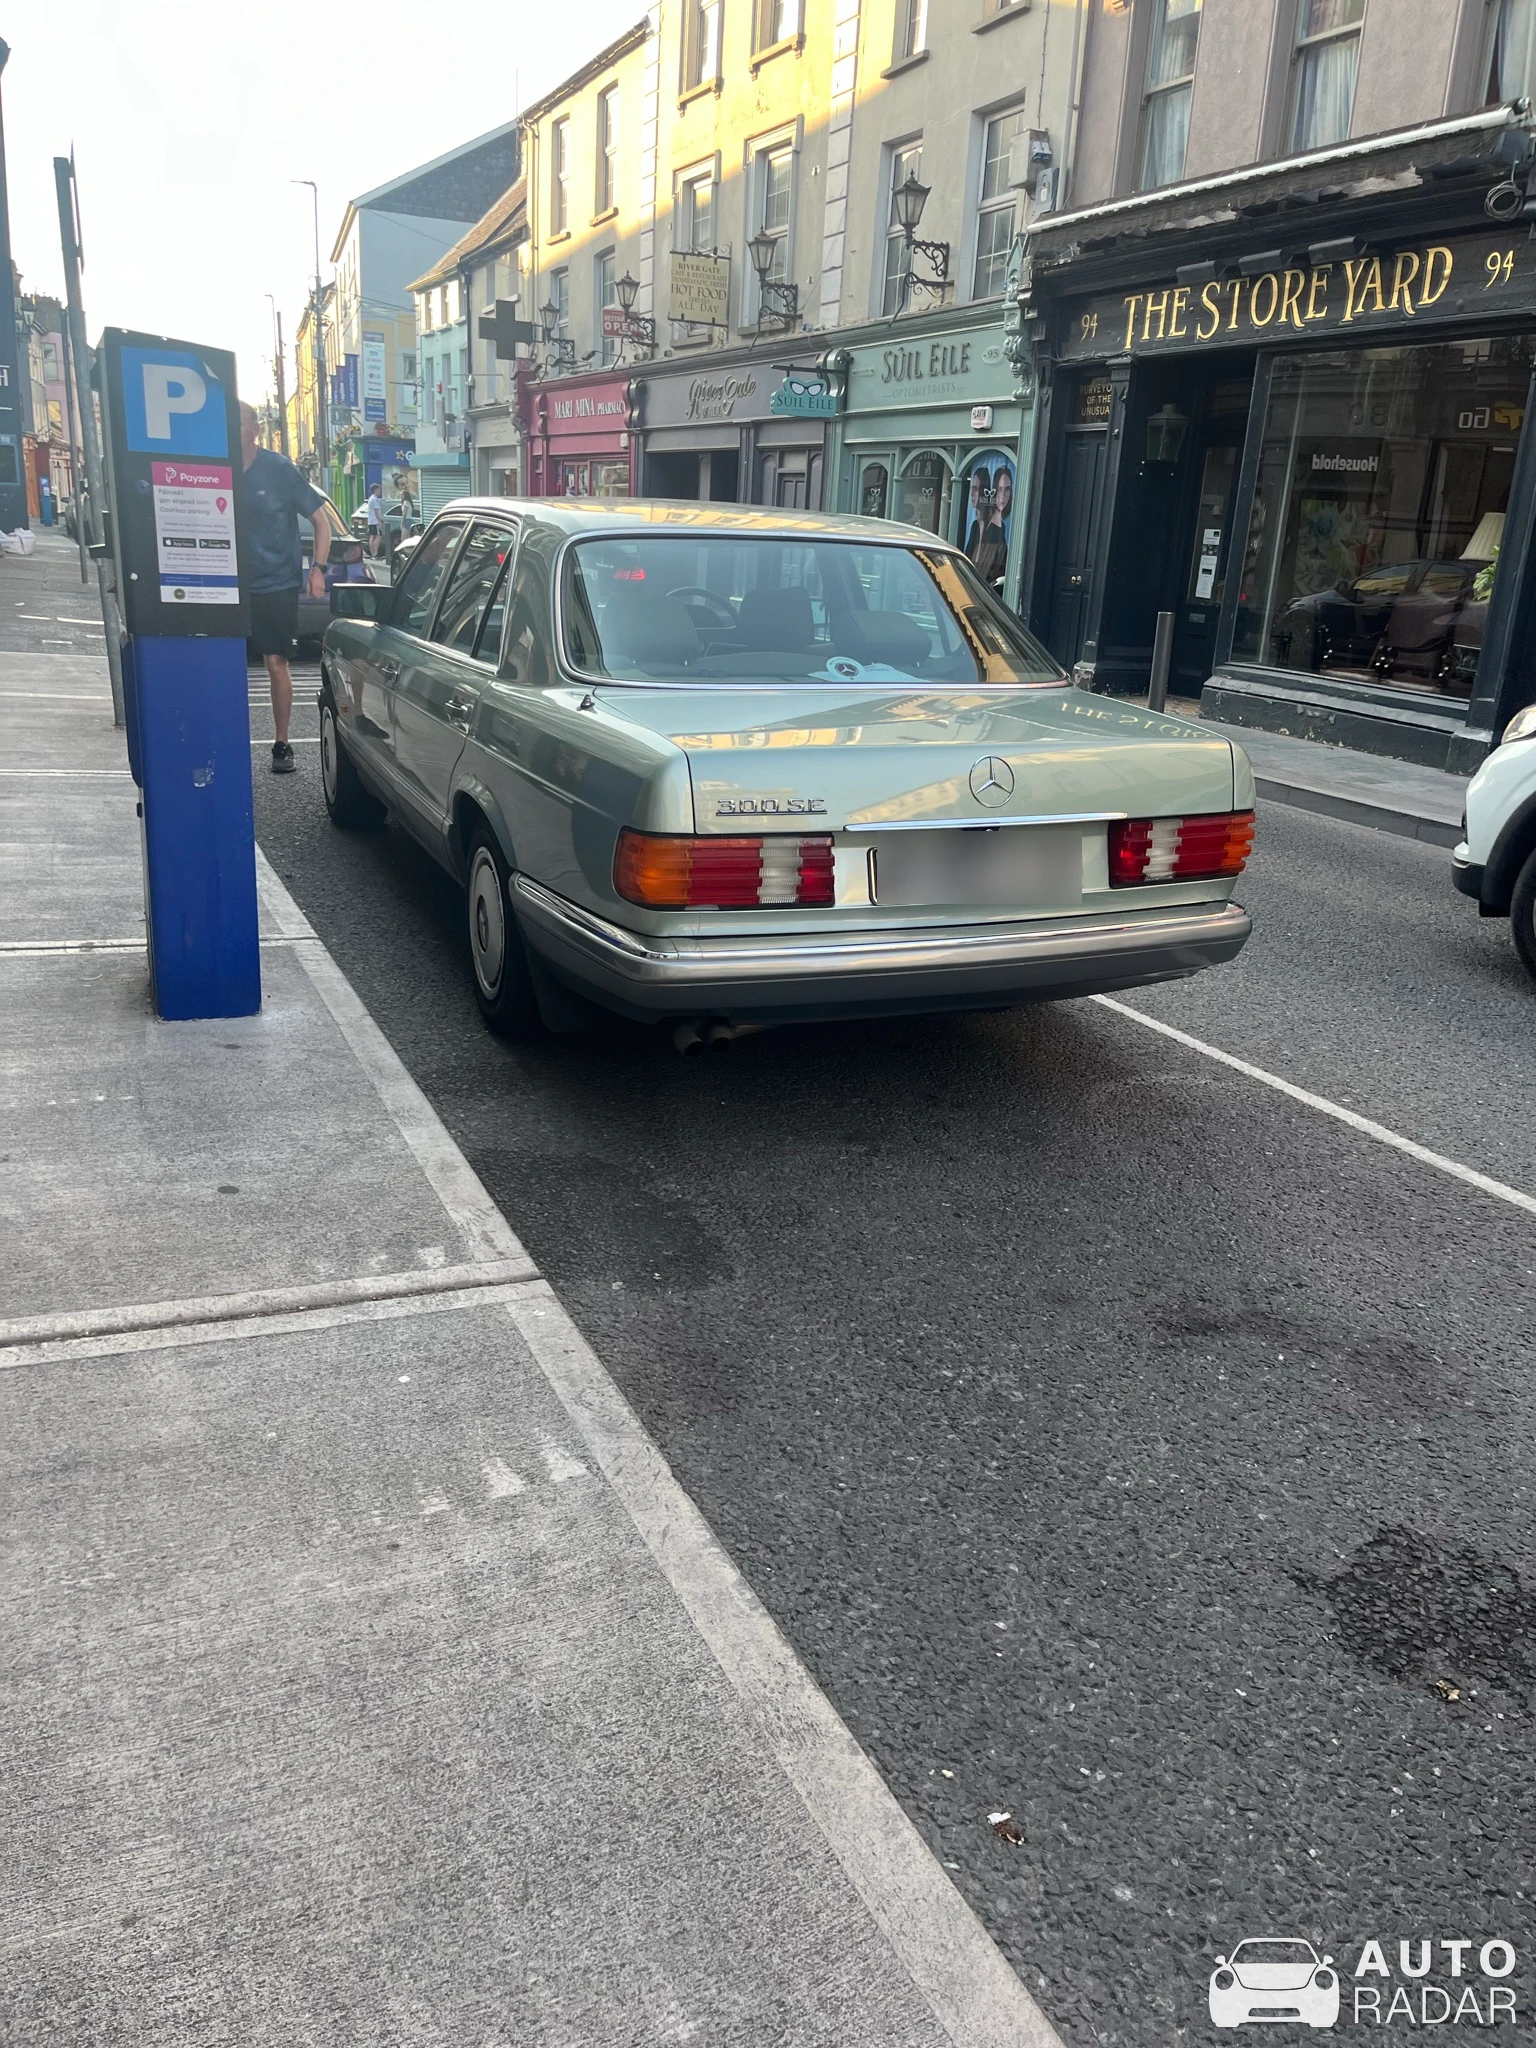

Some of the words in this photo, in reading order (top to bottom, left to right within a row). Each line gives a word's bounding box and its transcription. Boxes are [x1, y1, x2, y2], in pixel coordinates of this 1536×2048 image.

[678, 262, 700, 272] RIVER
[702, 266, 721, 274] GATE
[1484, 250, 1515, 290] 94
[692, 272, 727, 282] RESTAURANT
[671, 283, 694, 295] HOT
[697, 286, 727, 300] FOOD
[710, 281, 727, 289] FRESH
[689, 296, 709, 304] SERVED
[1124, 286, 1191, 350] THE
[1196, 262, 1333, 340] STORE
[1341, 245, 1453, 324] YARD
[678, 301, 694, 311] ALL
[700, 303, 719, 314] DAY
[604, 321, 638, 332] OPEN
[1080, 313, 1098, 342] 94
[881, 346, 923, 384] SÚIL
[929, 342, 971, 377] EILE
[685, 377, 724, 420] River
[722, 371, 756, 416] Gate
[892, 382, 956, 399] OPTOMETRISTS
[1080, 383, 1112, 395] PURVEYO
[142, 363, 207, 440] P
[808, 396, 833, 410] EILE
[1086, 396, 1096, 405] OF
[1098, 394, 1112, 404] THE
[554, 400, 573, 419] MARI
[576, 398, 595, 417] MINA
[1081, 405, 1110, 417] UNUSUA
[180, 473, 219, 485] Payzone
[172, 498, 195, 506] airgead
[188, 508, 211, 516] parking
[717, 798, 779, 814] 300
[787, 798, 827, 813] SE
